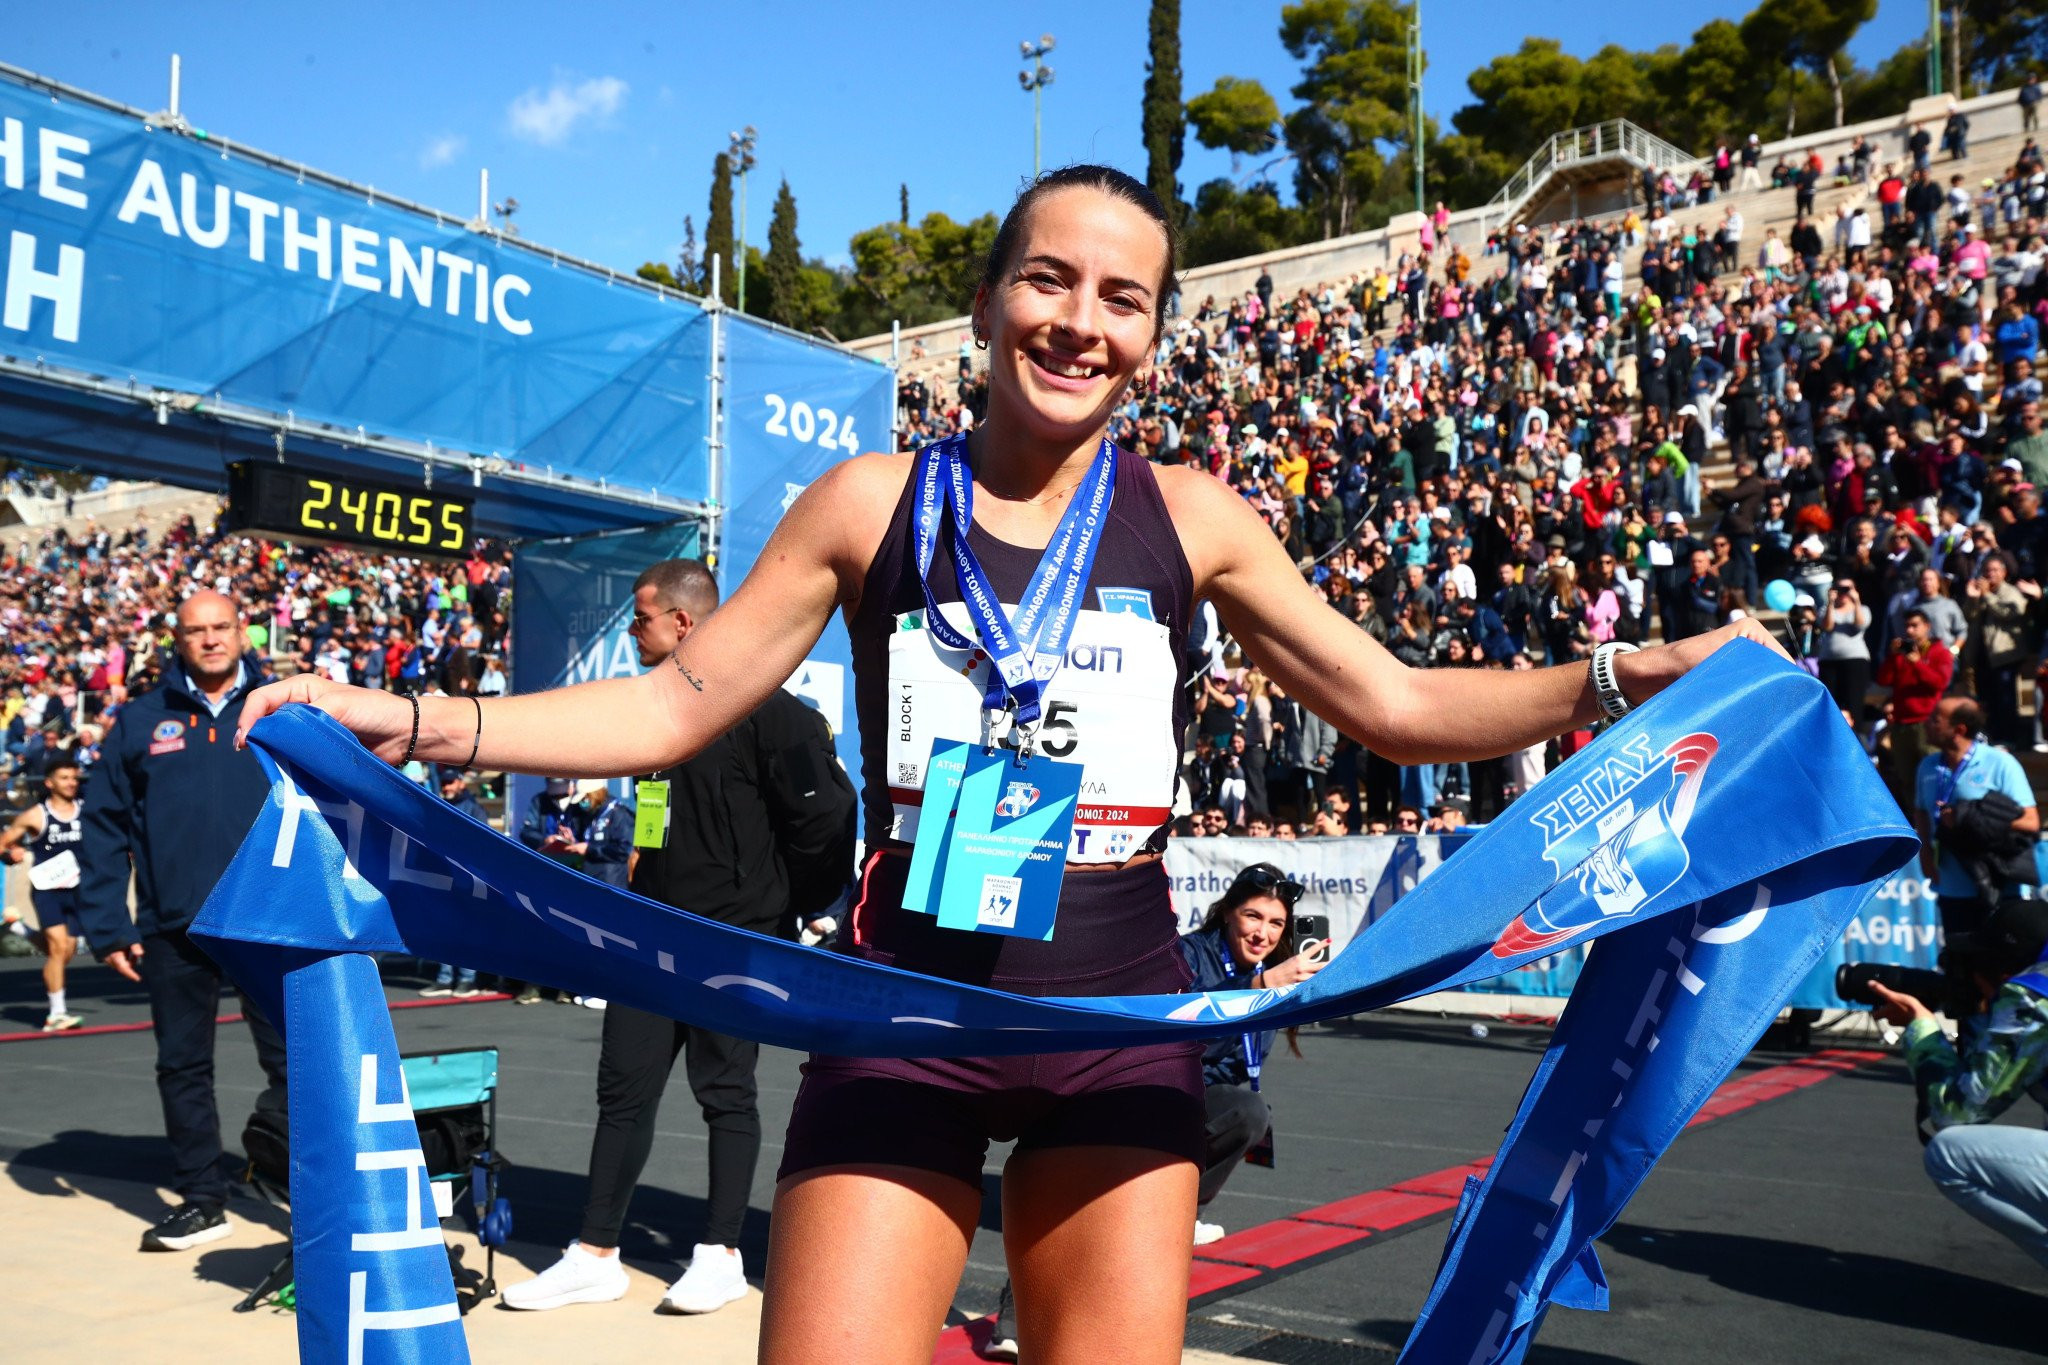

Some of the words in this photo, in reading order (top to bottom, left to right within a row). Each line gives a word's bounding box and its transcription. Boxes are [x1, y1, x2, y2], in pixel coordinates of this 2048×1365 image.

[117, 160, 534, 336] AUTHENTIC
[764, 393, 860, 456] 2024
[300, 480, 466, 549] 2.40.55
[1047, 573, 1080, 649] ΜΑΡΑΘΩΝΙΟΣ
[1092, 457, 1112, 517] ΑΥΘΕΝΤΙΚΟΣ
[568, 608, 628, 634] athens
[965, 576, 1010, 650] ΜΑΡΑΘΩΝΙΟΣ
[1018, 566, 1060, 636] ΜΑΡΑΘΩΝΙΟΣ
[901, 695, 912, 742] BLOCK
[1080, 782, 1107, 794] ΥΛΑ
[1106, 810, 1129, 820] 2024
[1529, 732, 1667, 846] ΣΕΓΑΣ
[1017, 850, 1052, 862] ΔΡΟΜΟΥ
